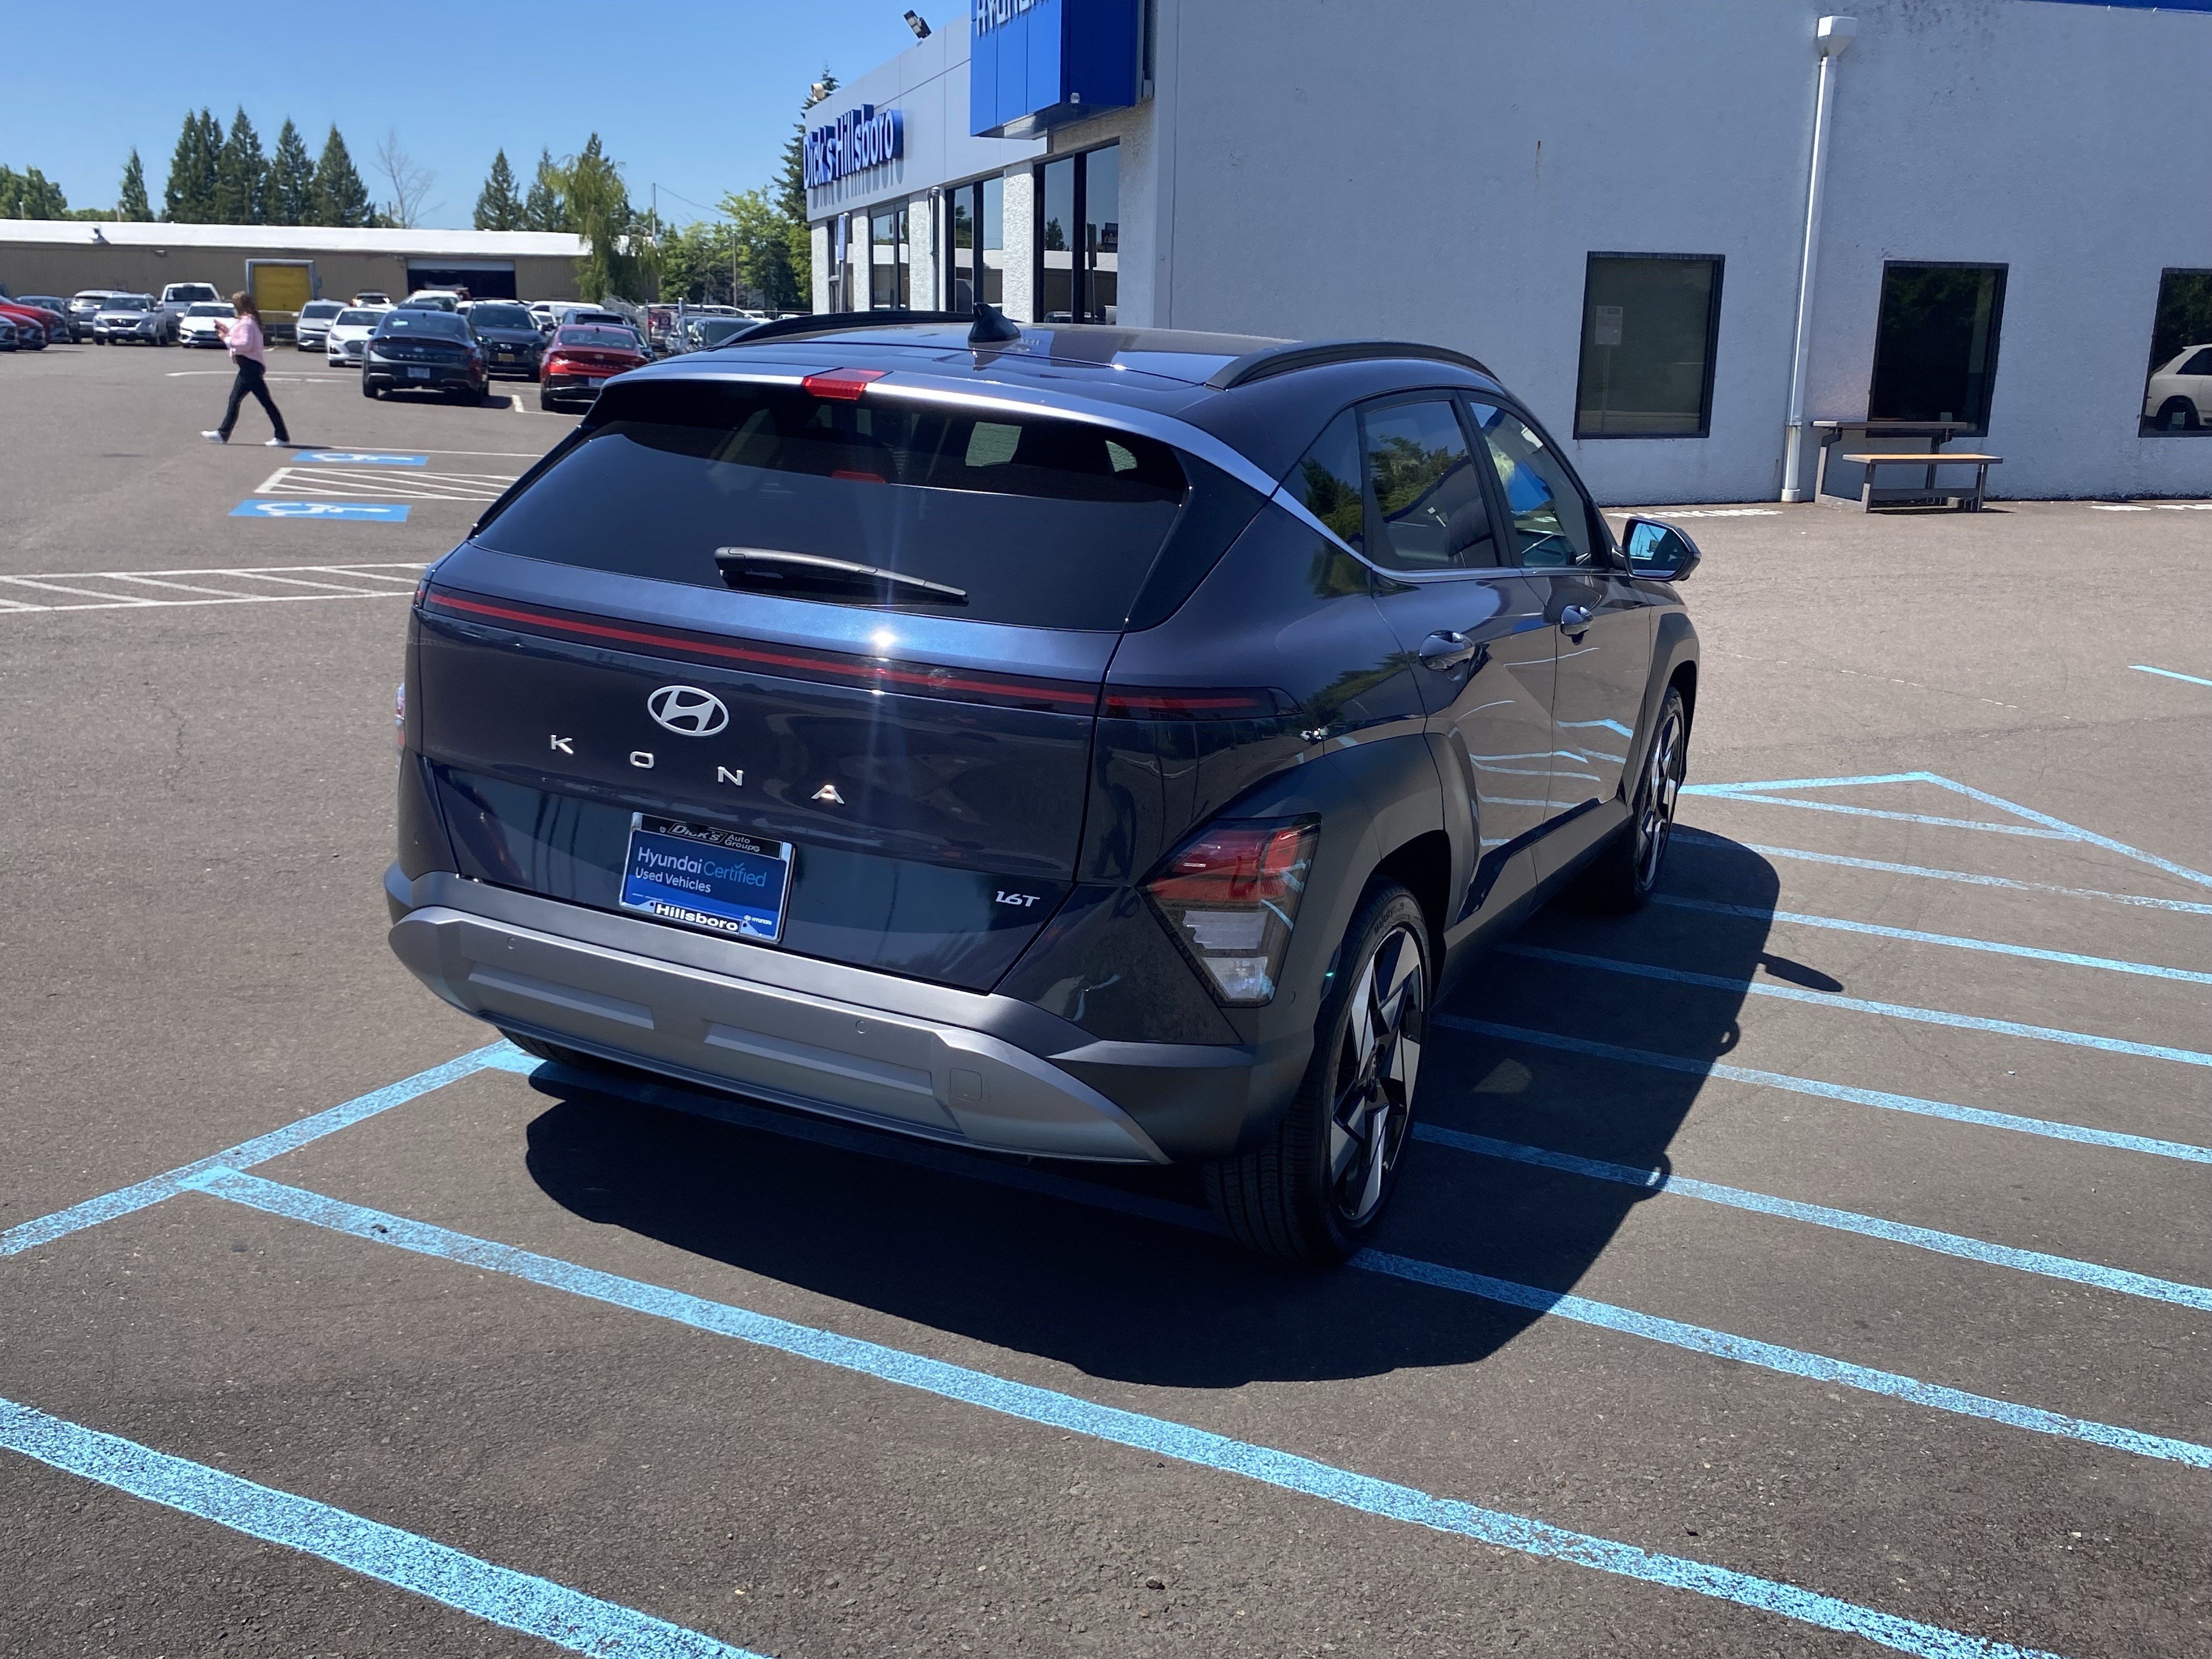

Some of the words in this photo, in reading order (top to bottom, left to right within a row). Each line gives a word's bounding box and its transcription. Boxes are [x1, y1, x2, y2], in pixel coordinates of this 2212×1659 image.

[803, 126, 834, 189] Dick's
[836, 104, 899, 177] Hillsboro
[551, 735, 845, 805] KONA
[725, 839, 754, 851] Group
[727, 834, 751, 844] Auto
[635, 867, 663, 883] Used
[665, 872, 712, 893] Vehicles
[637, 847, 703, 874] Hyundai
[703, 861, 767, 887] Certified
[656, 904, 738, 931] Hillsboro
